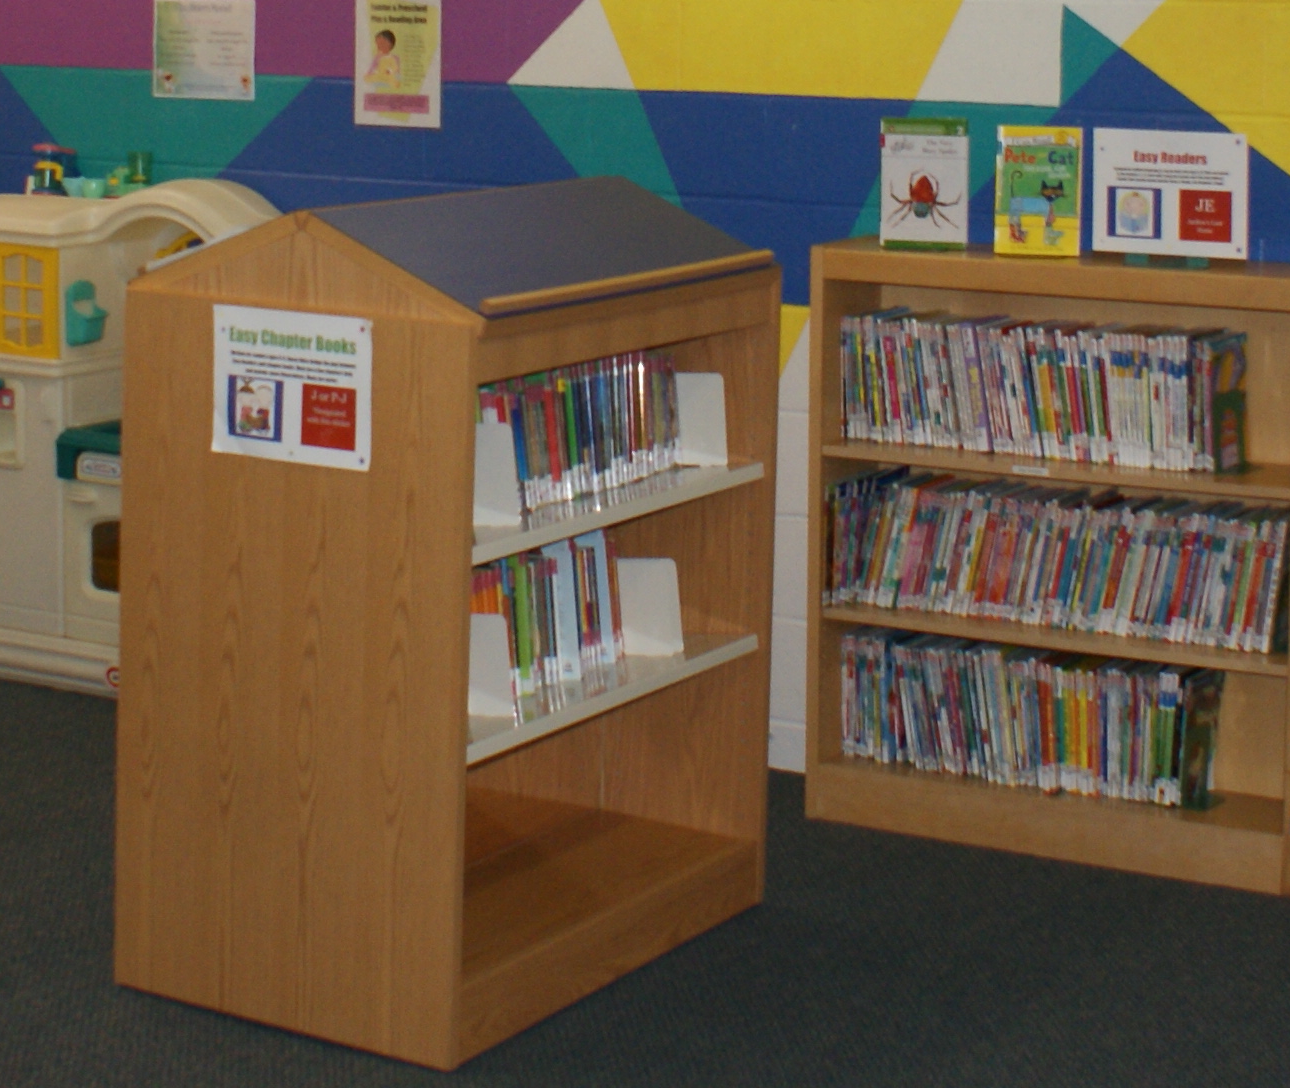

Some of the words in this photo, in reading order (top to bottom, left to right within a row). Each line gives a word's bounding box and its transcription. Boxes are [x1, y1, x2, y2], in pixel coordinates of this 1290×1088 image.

[1004, 147, 1037, 165] Pete
[1048, 150, 1074, 166] Cat
[1133, 150, 1158, 164] Easy
[1160, 151, 1208, 166] Readers
[1195, 197, 1216, 213] JE
[228, 325, 258, 346] Easy
[260, 328, 313, 350] Chapter
[315, 335, 357, 355] Books
